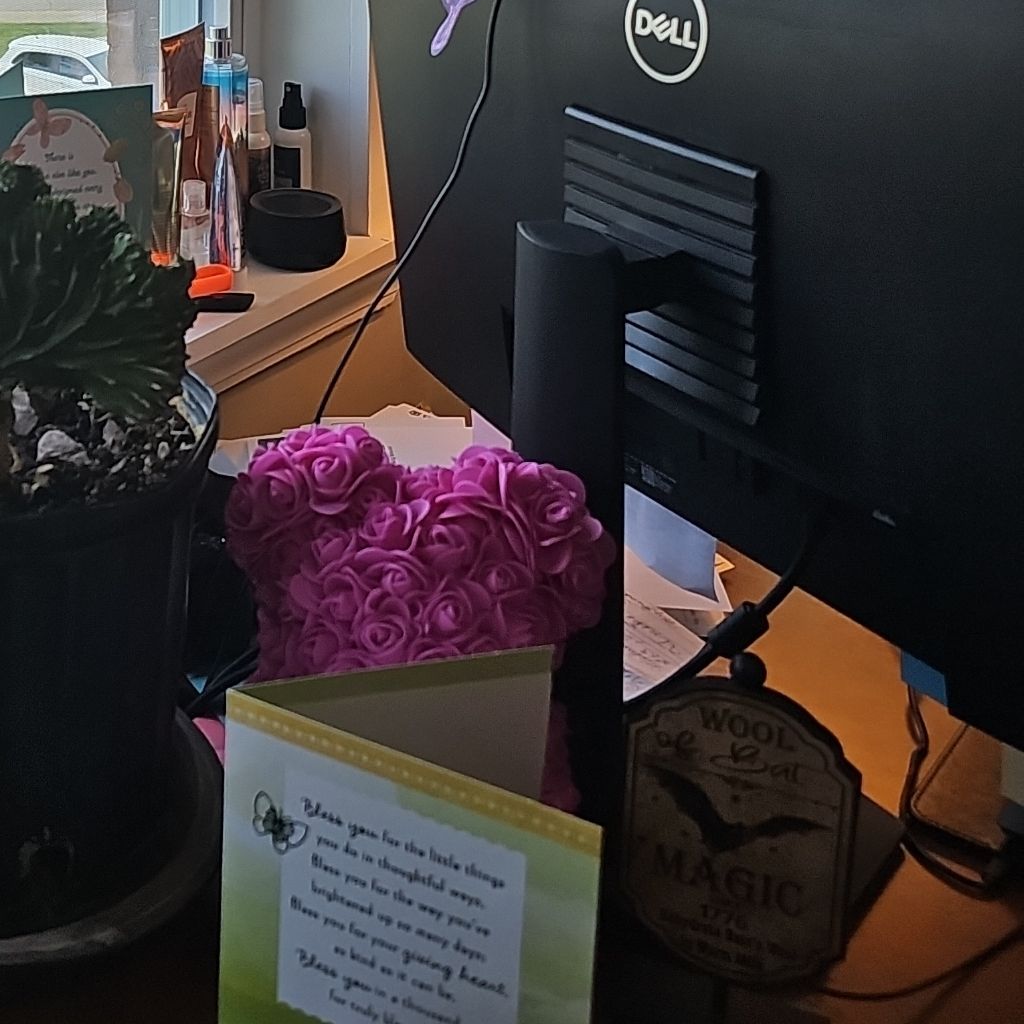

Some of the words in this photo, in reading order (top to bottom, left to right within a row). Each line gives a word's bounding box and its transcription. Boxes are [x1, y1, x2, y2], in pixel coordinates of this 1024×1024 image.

[635, 8, 697, 50] DELL
[699, 706, 796, 752] WOOL
[301, 797, 344, 827] Bless
[348, 822, 379, 840] you
[382, 829, 401, 848] for
[404, 840, 426, 858] the
[429, 846, 461, 872] little
[465, 862, 506, 889] things
[316, 835, 340, 851] you
[343, 842, 359, 859] do
[361, 851, 374, 864] in
[378, 856, 446, 893] thoughtful
[311, 853, 340, 878] Bless
[344, 872, 368, 889] you
[371, 877, 390, 896] for
[393, 888, 414, 907] the
[417, 903, 443, 922] way
[311, 879, 374, 917] brightened
[377, 912, 394, 927] up
[397, 920, 412, 933] so
[415, 928, 450, 949] many
[654, 844, 803, 918] MAGIC
[290, 895, 320, 920] Bless
[323, 916, 346, 931] you
[349, 921, 368, 939] for
[371, 937, 399, 953] your
[402, 949, 454, 982] giving
[350, 947, 376, 969] kind
[397, 971, 407, 981] it
[411, 978, 434, 992] can
[295, 948, 338, 979] Bless
[342, 976, 372, 992] you
[374, 987, 387, 998] in
[390, 996, 399, 1004] a
[402, 996, 461, 1024] thousand
[329, 988, 347, 1006] for
[350, 1001, 380, 1022] truly
